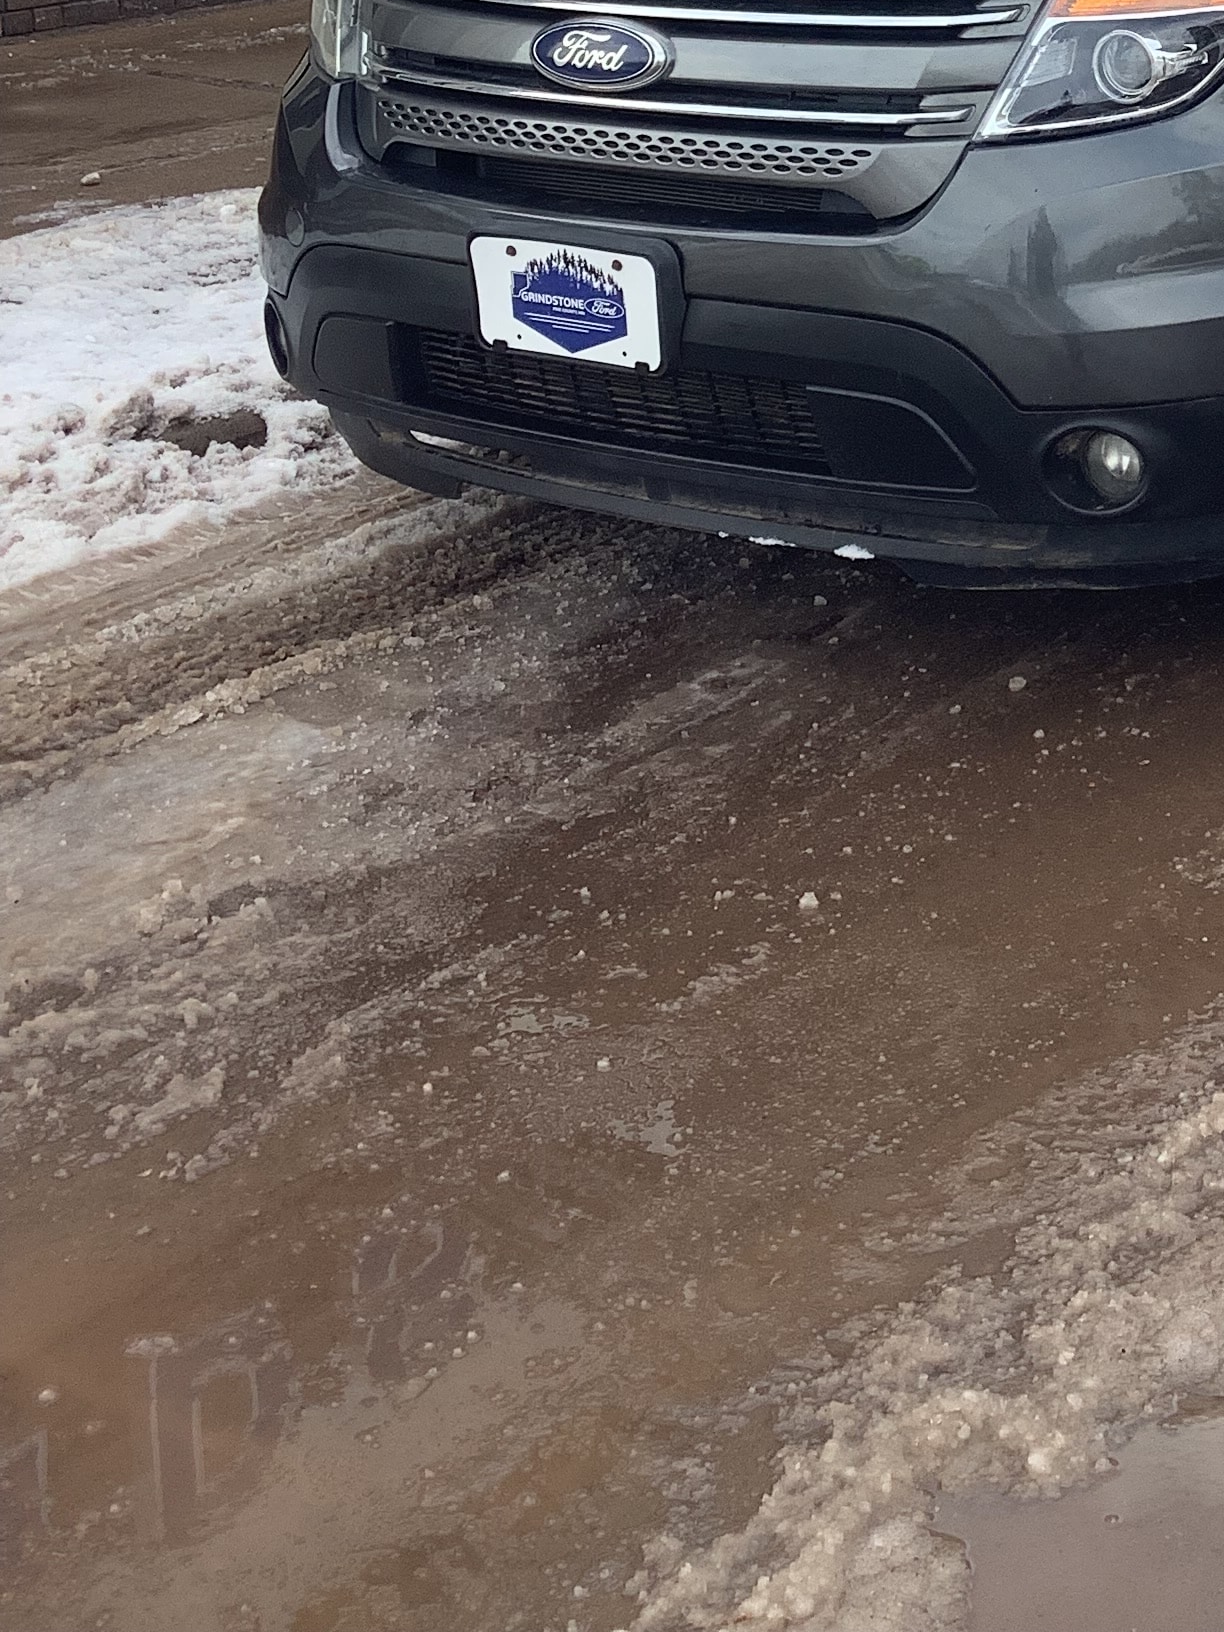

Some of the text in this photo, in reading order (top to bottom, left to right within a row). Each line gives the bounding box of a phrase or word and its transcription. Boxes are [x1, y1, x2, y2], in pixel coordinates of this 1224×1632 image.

[552, 30, 629, 72] Ford
[521, 291, 617, 316] GRINDSTONE Ford
